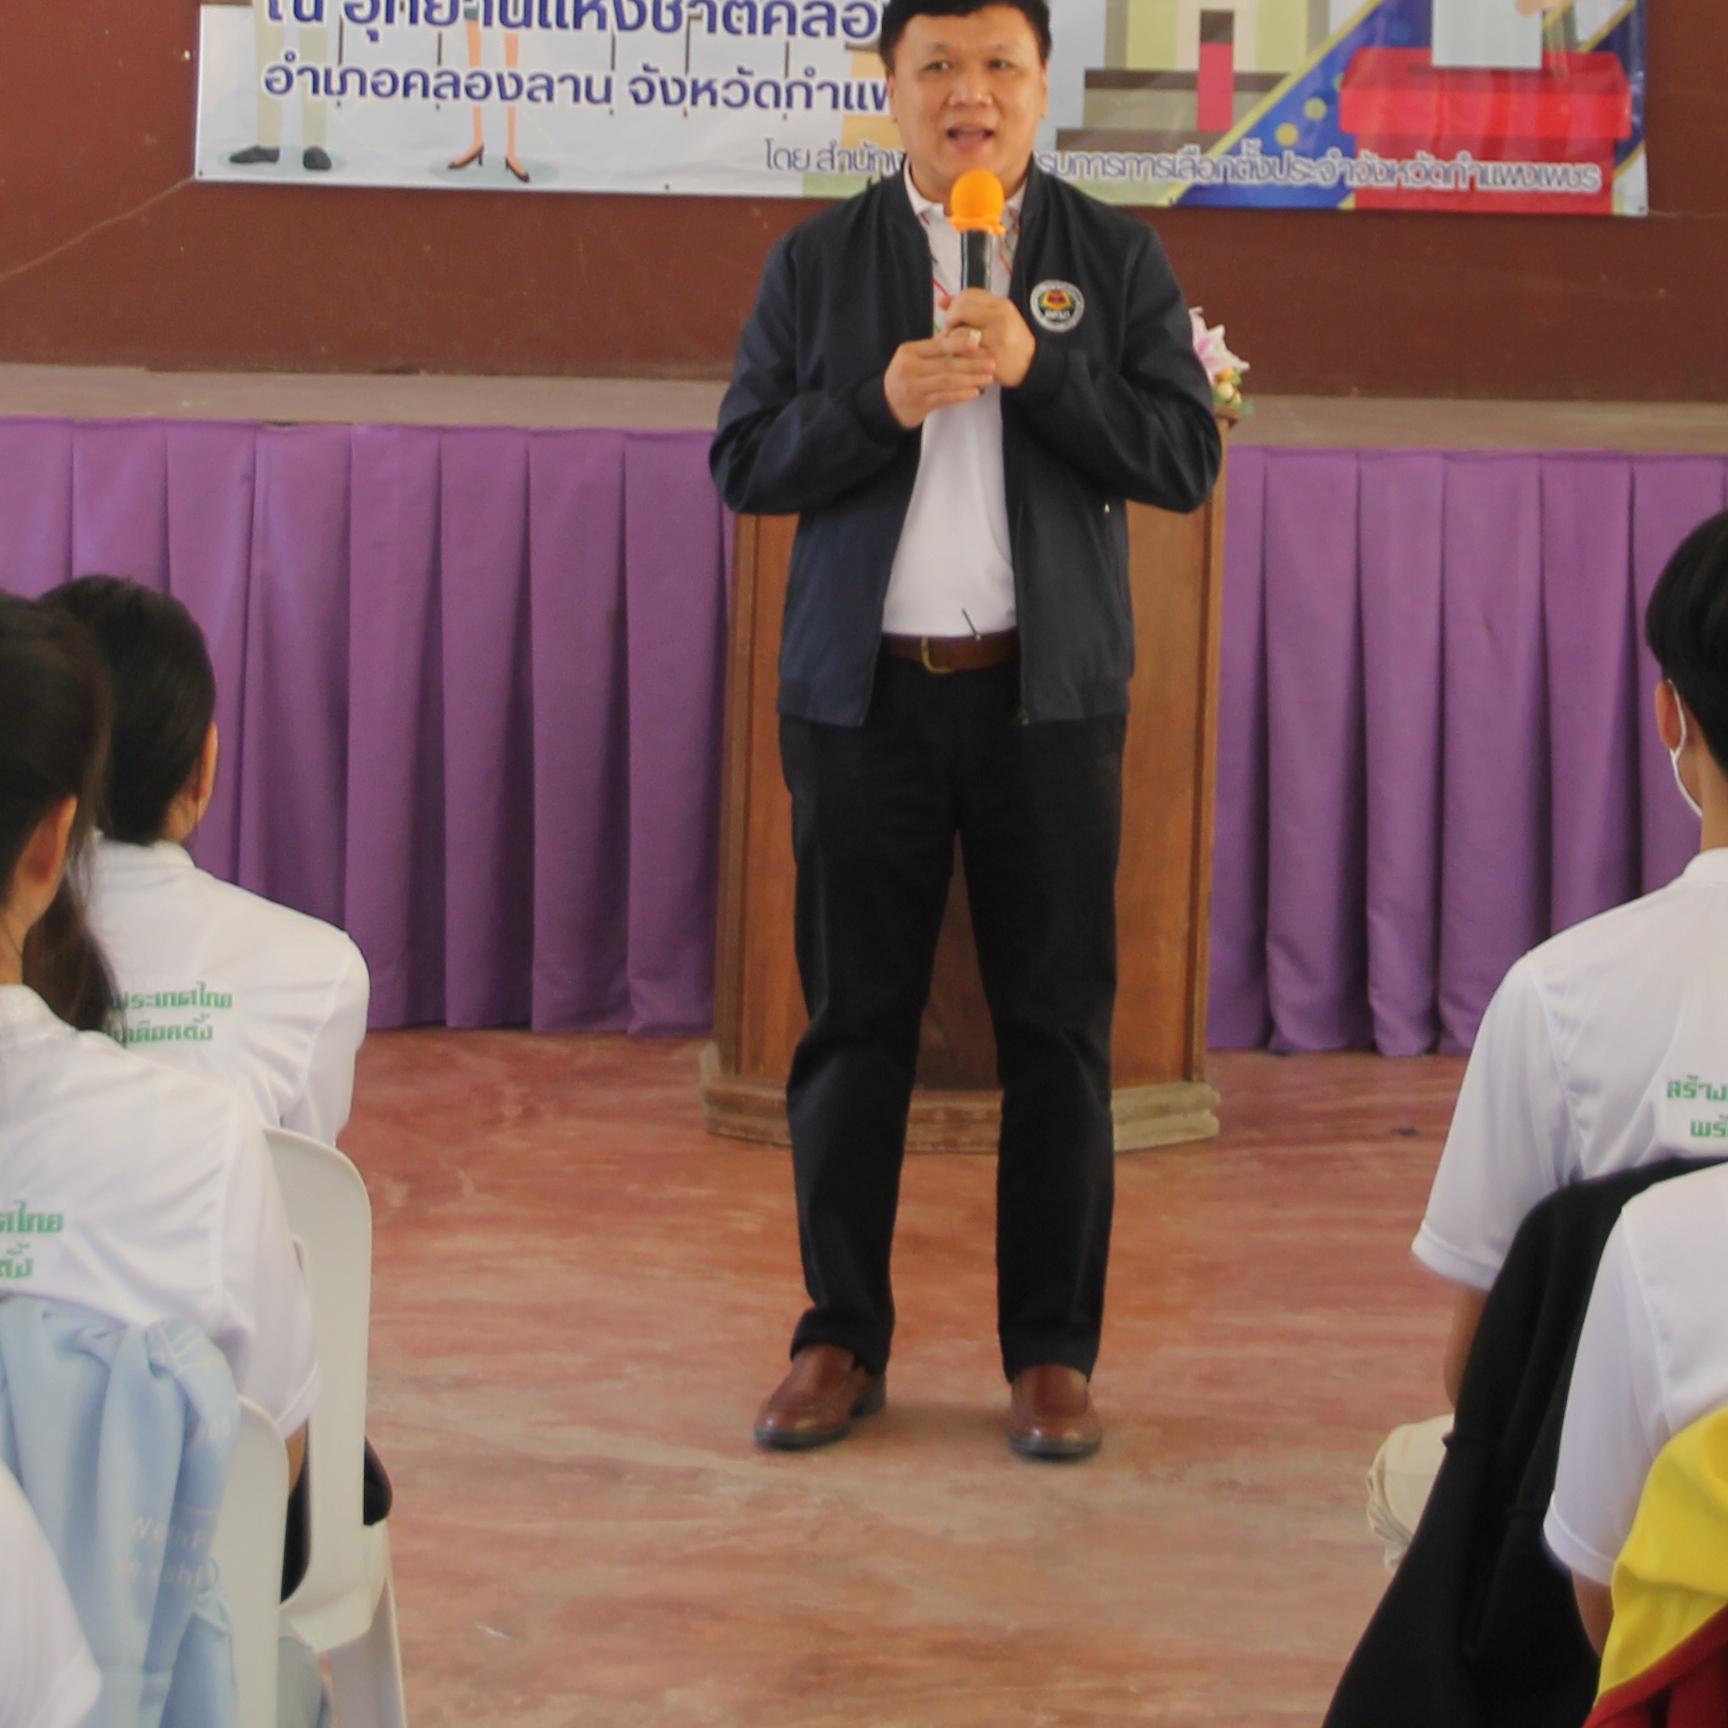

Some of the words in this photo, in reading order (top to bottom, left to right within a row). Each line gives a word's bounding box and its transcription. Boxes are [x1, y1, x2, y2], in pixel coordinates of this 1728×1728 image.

[264, 55, 613, 109] อำเภอคลองลาน
[764, 138, 812, 171] โดย
